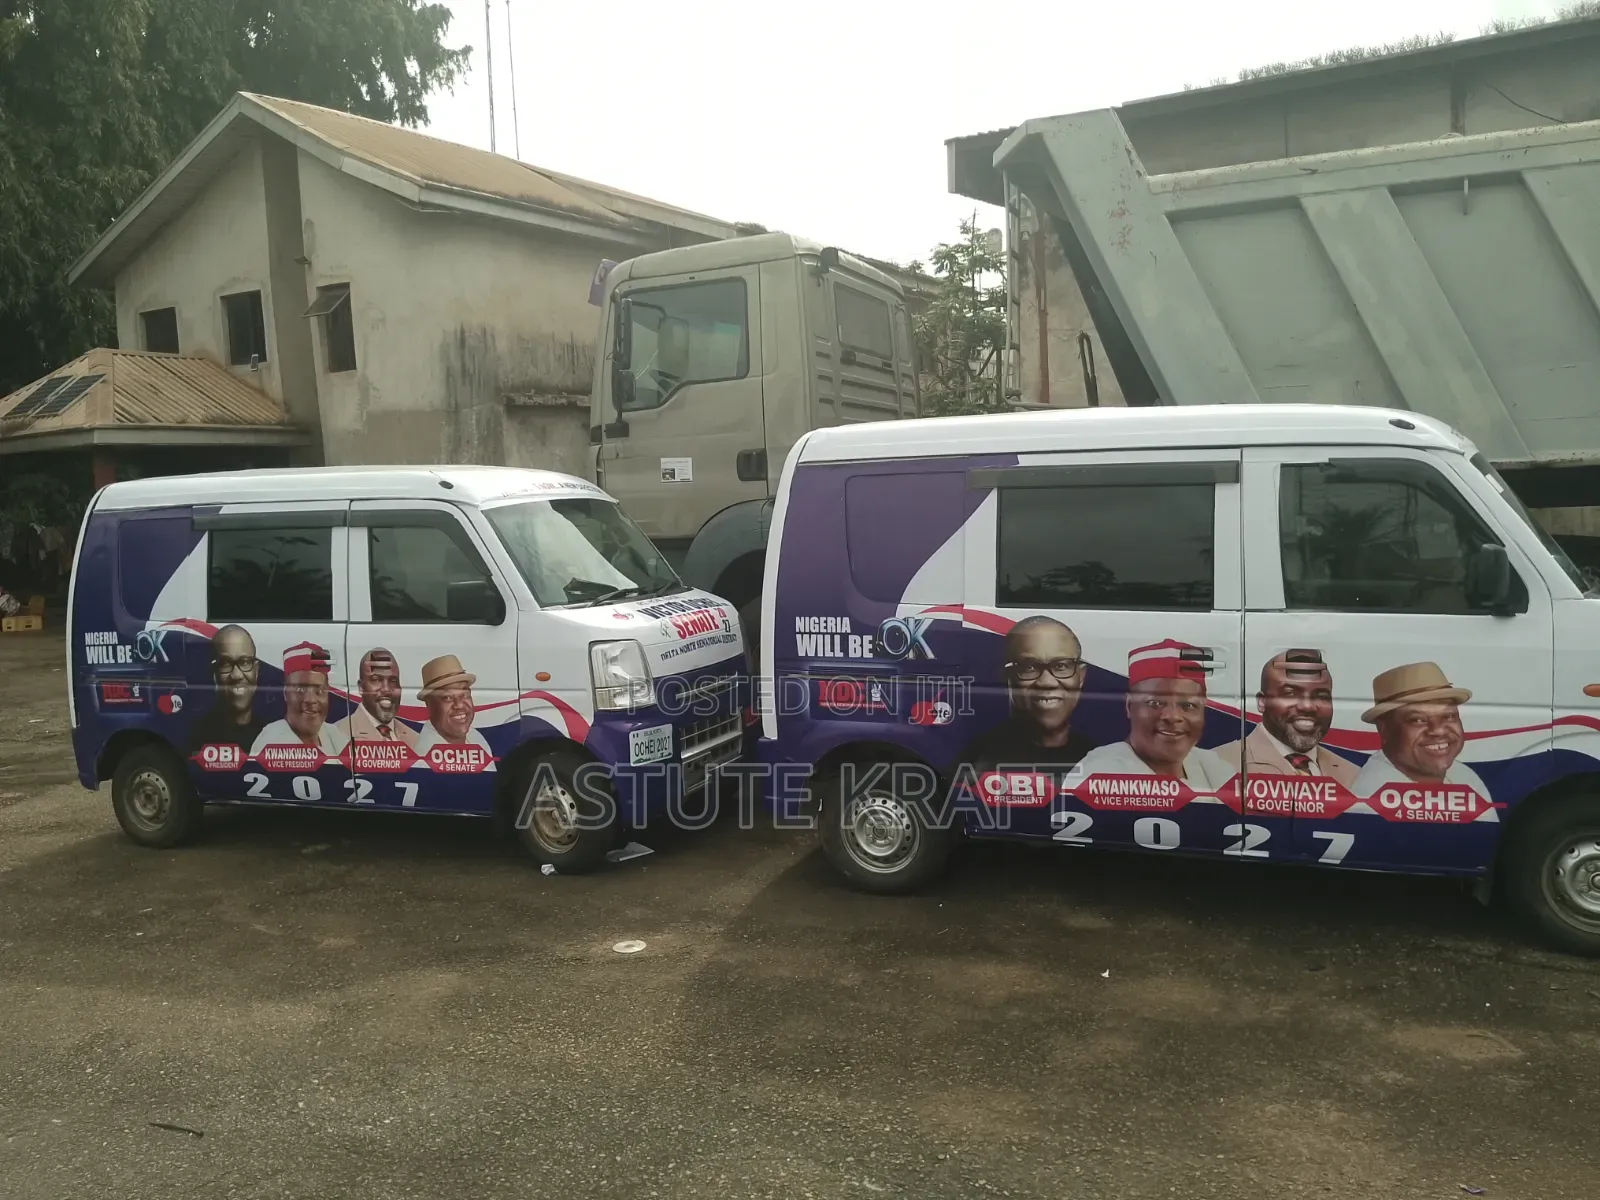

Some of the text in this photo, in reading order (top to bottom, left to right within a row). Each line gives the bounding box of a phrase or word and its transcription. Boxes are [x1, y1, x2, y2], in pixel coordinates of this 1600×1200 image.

[669, 609, 719, 639] SENATE
[794, 616, 851, 633] NIGERIA
[85, 631, 118, 645] NIGERIA
[796, 633, 873, 659] WILL BE
[877, 616, 937, 660] OK
[85, 645, 132, 664] WILL BE
[135, 630, 169, 664] OK
[660, 650, 679, 661] DELTA
[680, 642, 696, 654] NORTH
[696, 636, 722, 648] SENATORIAL
[203, 746, 240, 762] OBI
[264, 747, 318, 760] KWANKWASO
[634, 736, 670, 757] OCHEI 2027
[356, 760, 400, 769] 4 GOVERNOR
[431, 749, 485, 764] OCHEI
[446, 764, 476, 772] SENATE
[984, 775, 1045, 796] OBI
[1089, 779, 1180, 796] KWANKWASO
[987, 795, 1044, 804] 4 PRESIDENT
[1094, 797, 1175, 807] 4 VICE PRESIDENT
[1247, 800, 1325, 813] 4 GOVERNOR
[1380, 788, 1476, 812] OCHEI
[1395, 809, 1461, 822] 4 SENATE
